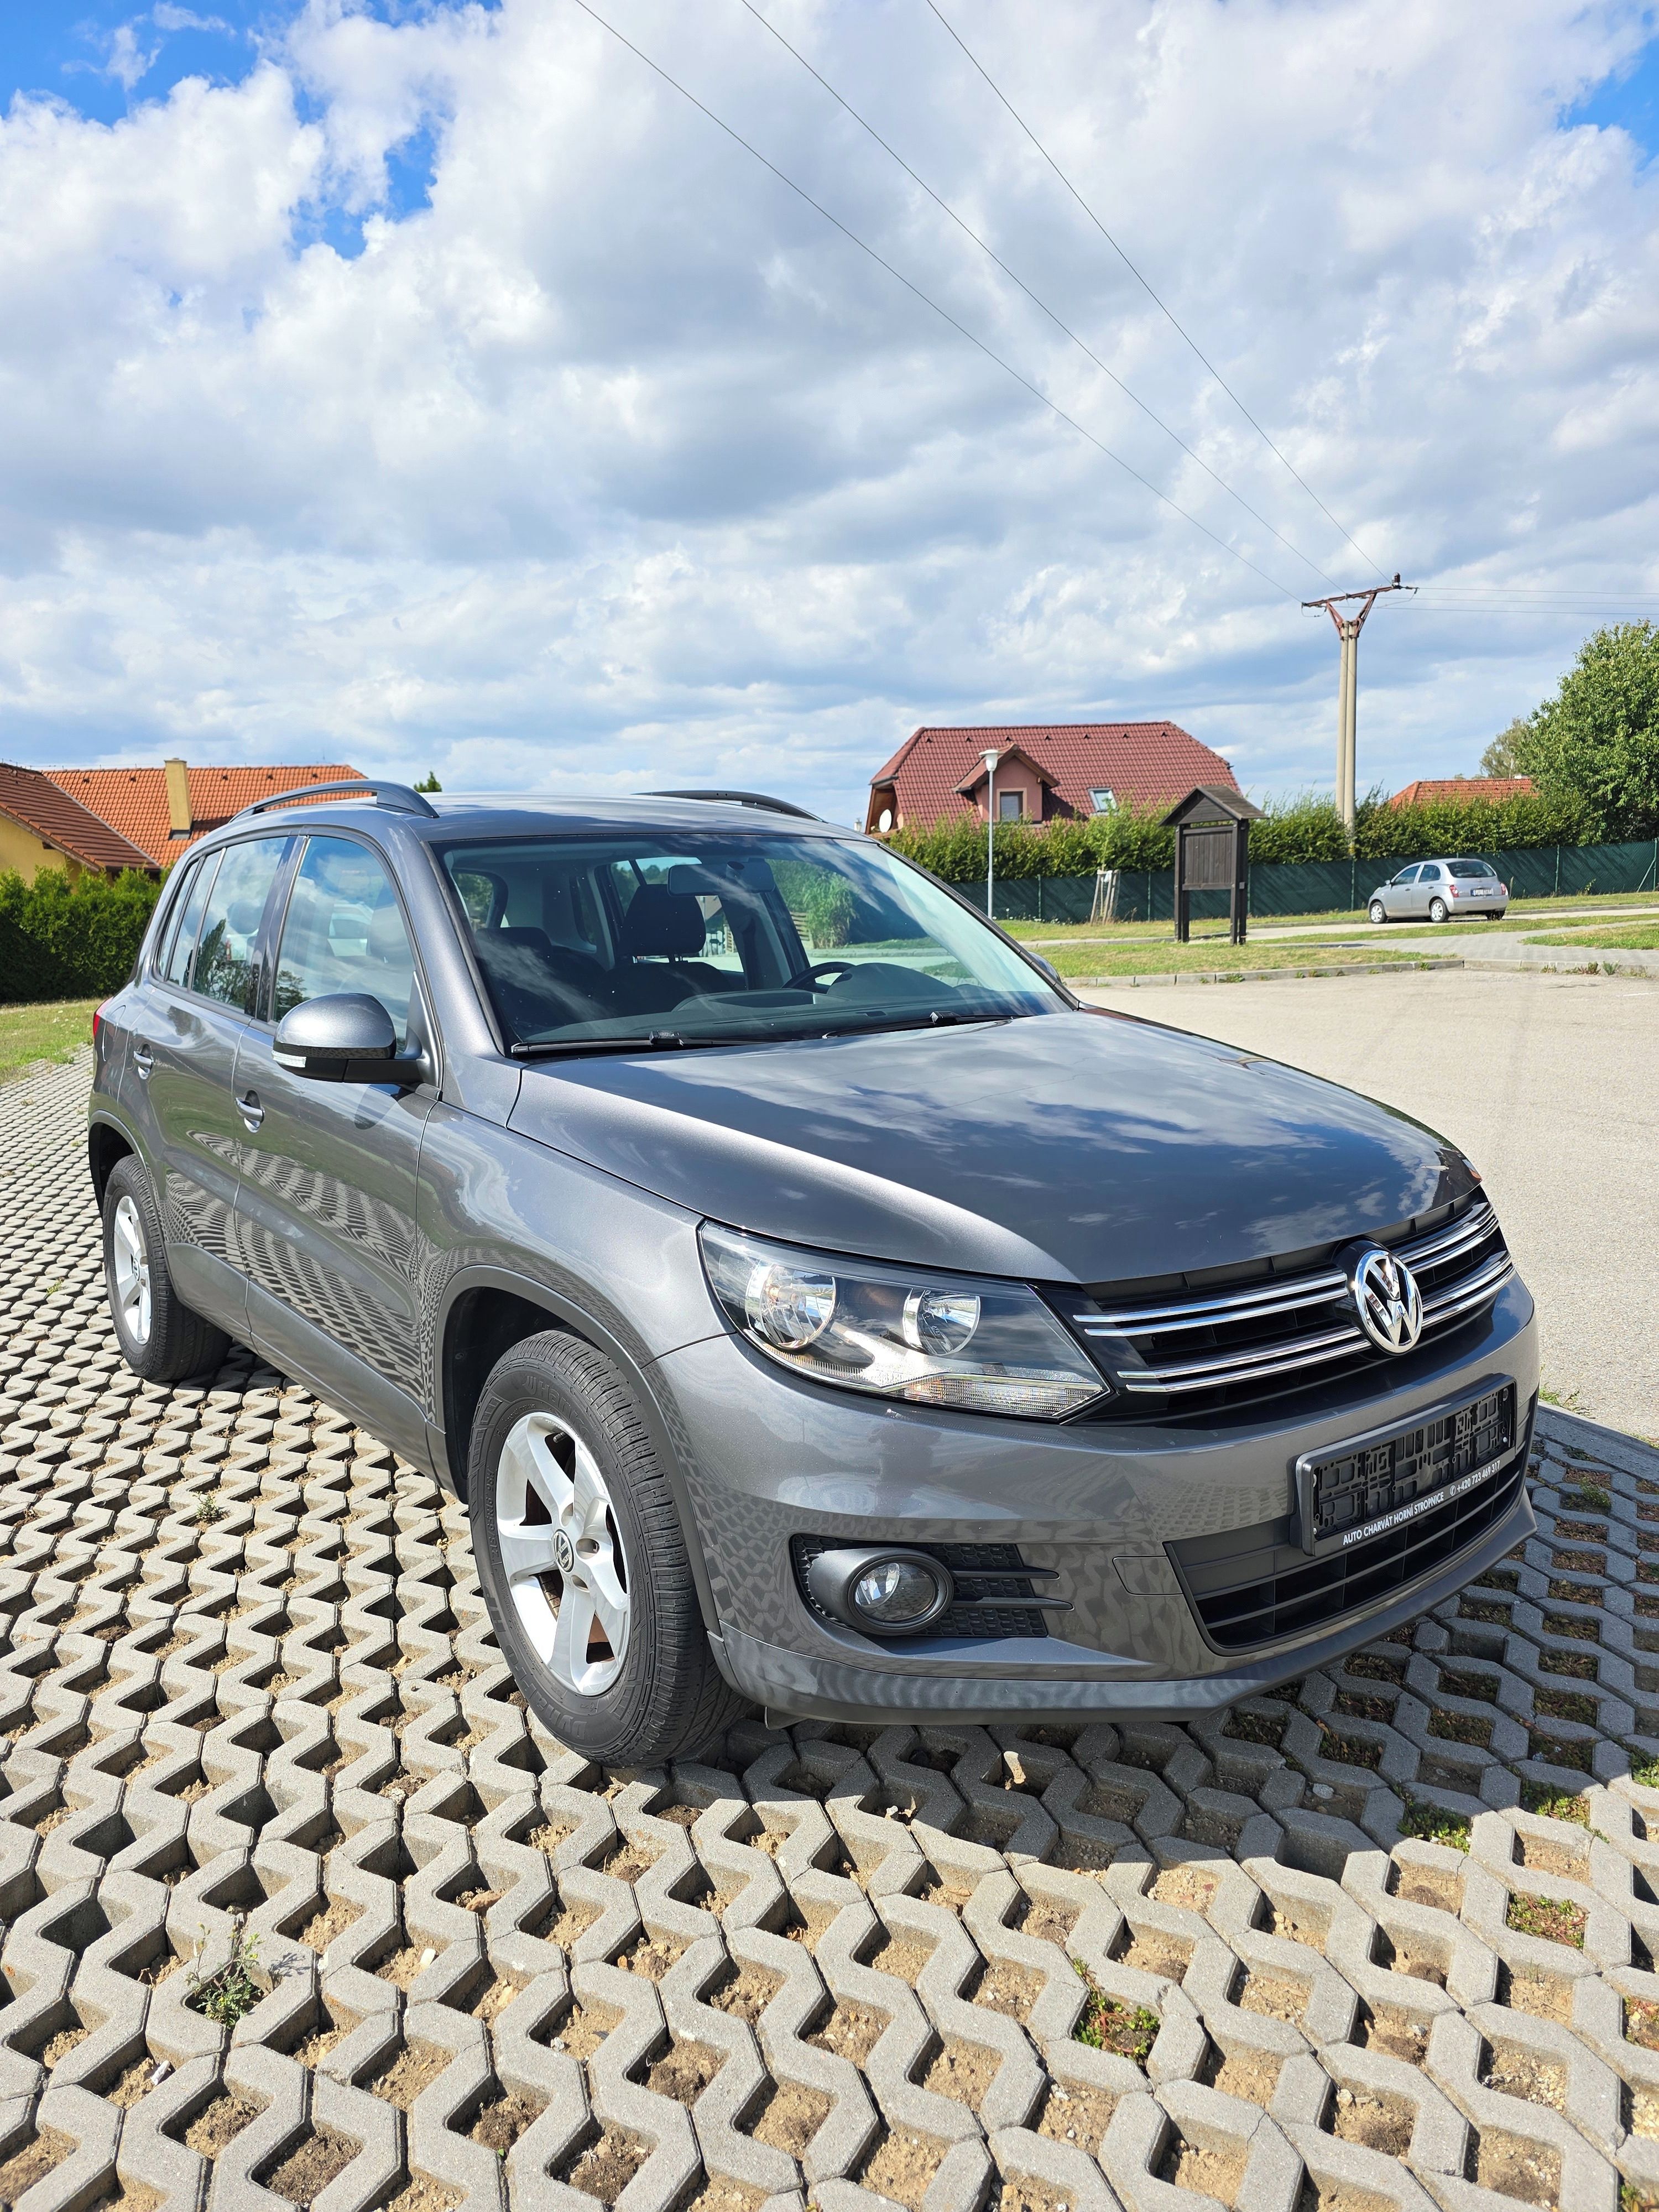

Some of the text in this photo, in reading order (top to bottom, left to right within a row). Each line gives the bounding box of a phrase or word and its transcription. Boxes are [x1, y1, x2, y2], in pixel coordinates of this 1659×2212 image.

[1343, 1460, 1500, 1545] AUTO CHARVÁT HORNÍ STROPNICE +420 723 469 317
